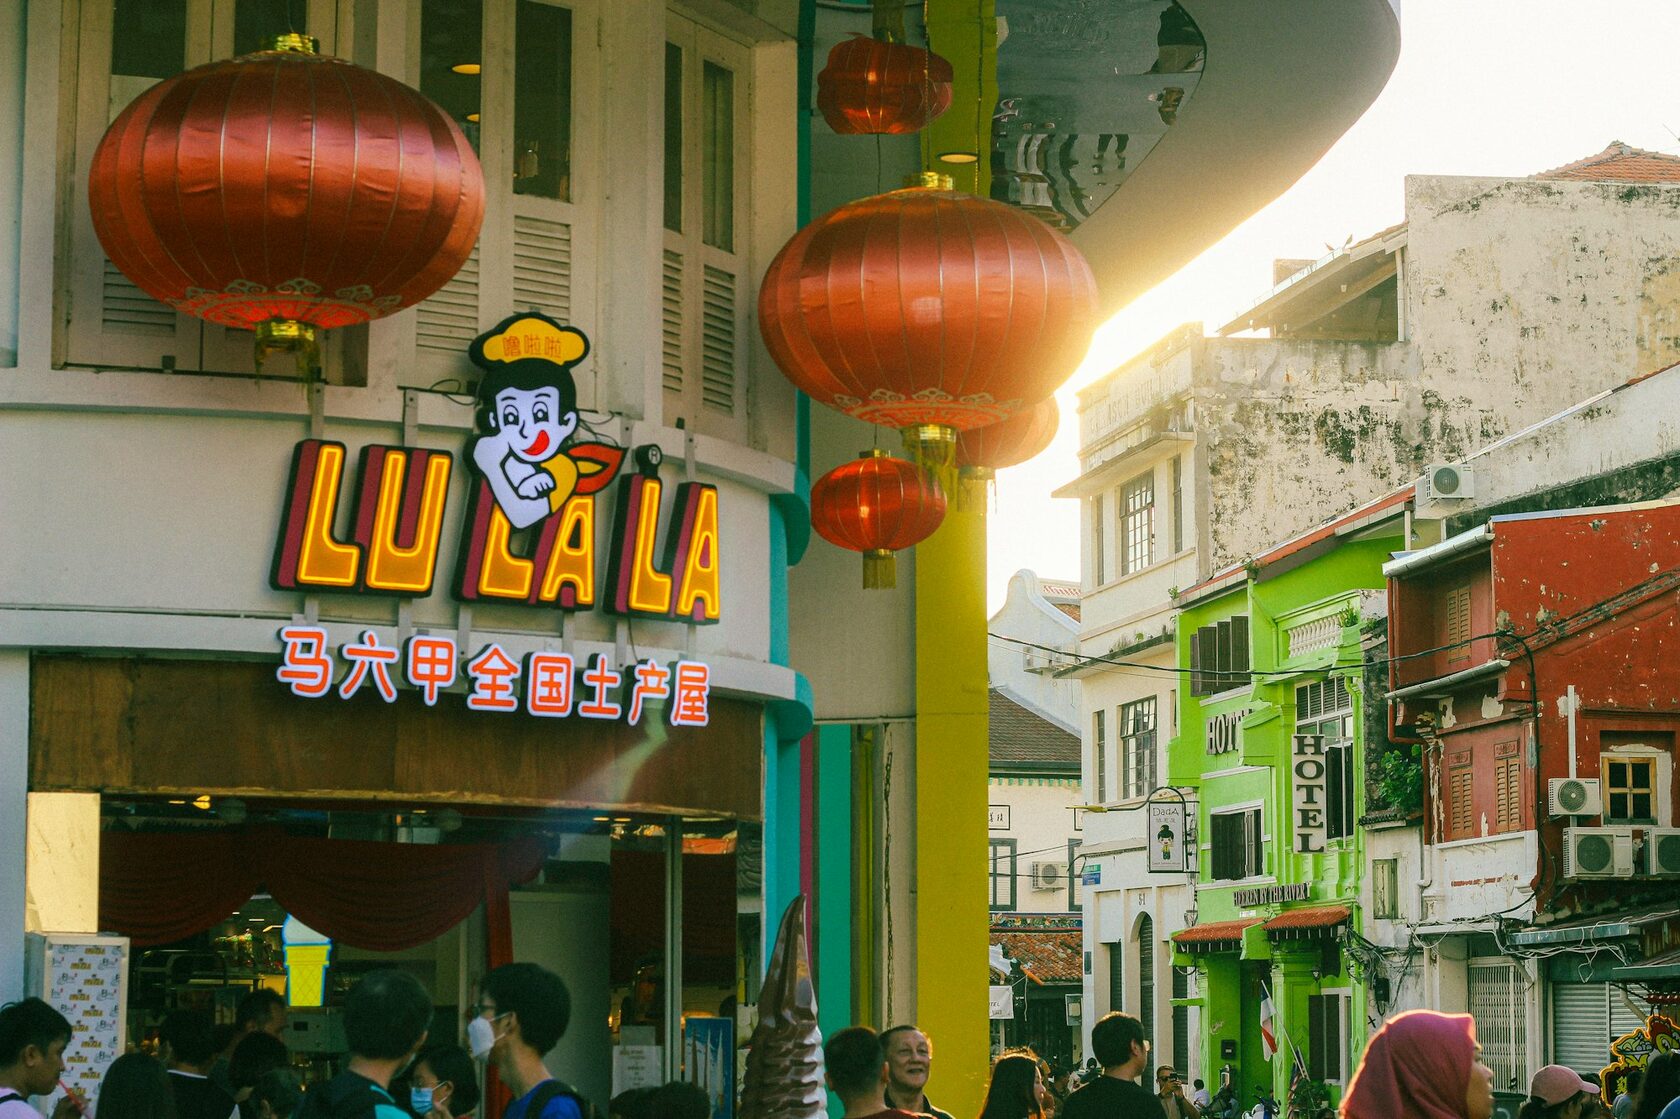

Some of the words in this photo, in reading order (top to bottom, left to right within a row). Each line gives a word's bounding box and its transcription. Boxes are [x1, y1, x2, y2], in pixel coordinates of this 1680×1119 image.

[277, 626, 711, 727] 马六甲全国土产屋
[1206, 709, 1253, 756] HOT
[1294, 735, 1325, 853] HOTEL
